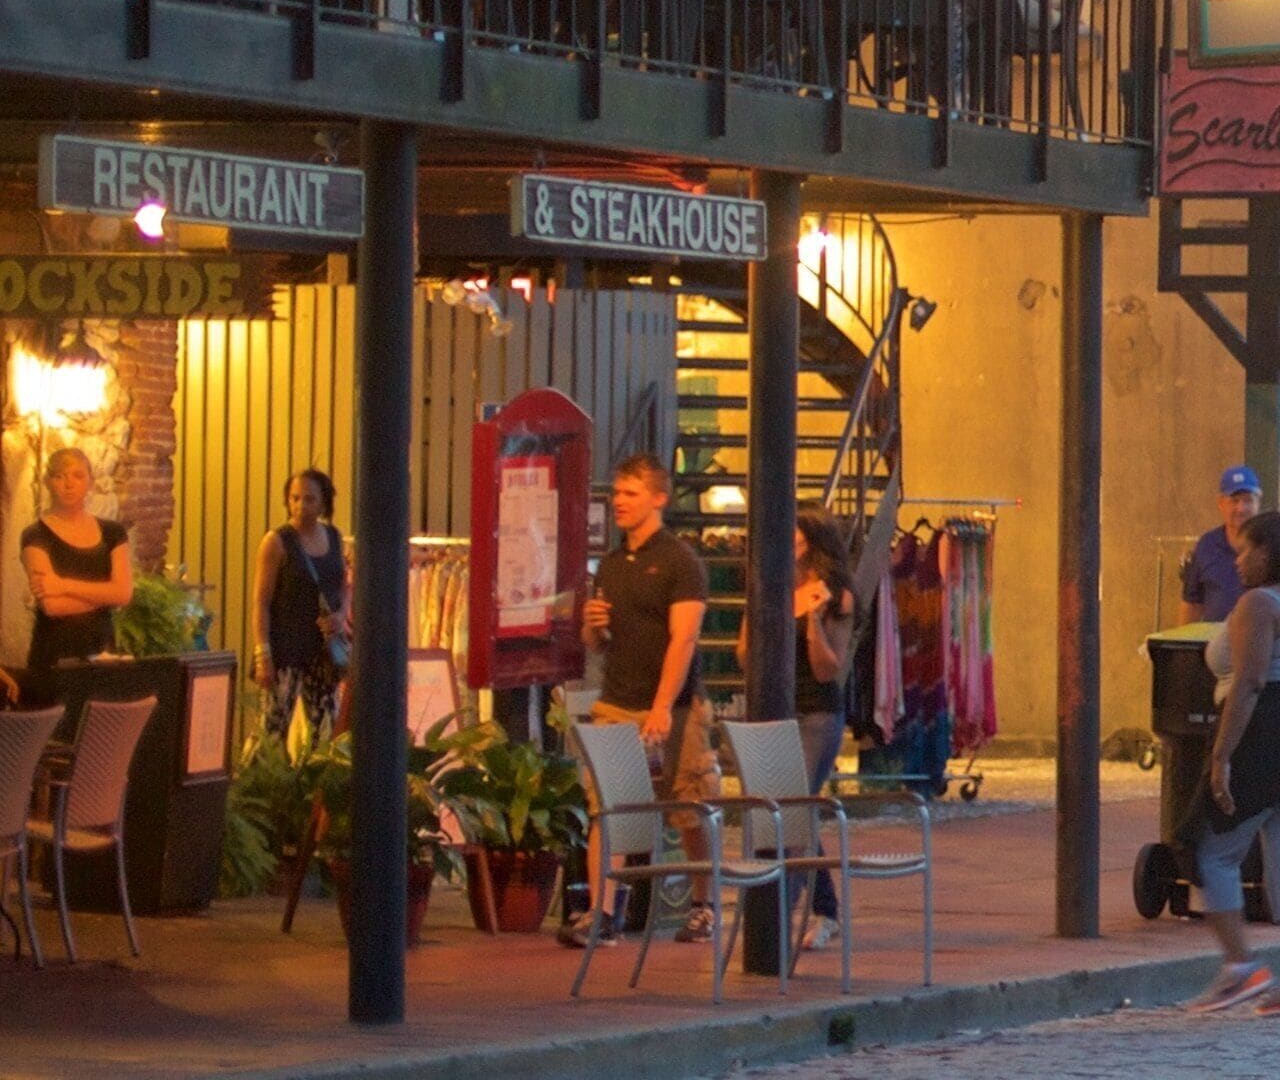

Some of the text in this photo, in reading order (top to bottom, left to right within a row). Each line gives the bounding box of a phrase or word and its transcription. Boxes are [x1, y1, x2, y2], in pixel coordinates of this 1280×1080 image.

[94, 147, 329, 227] RESTAURANT
[534, 183, 758, 254] & STEAKHOUSE
